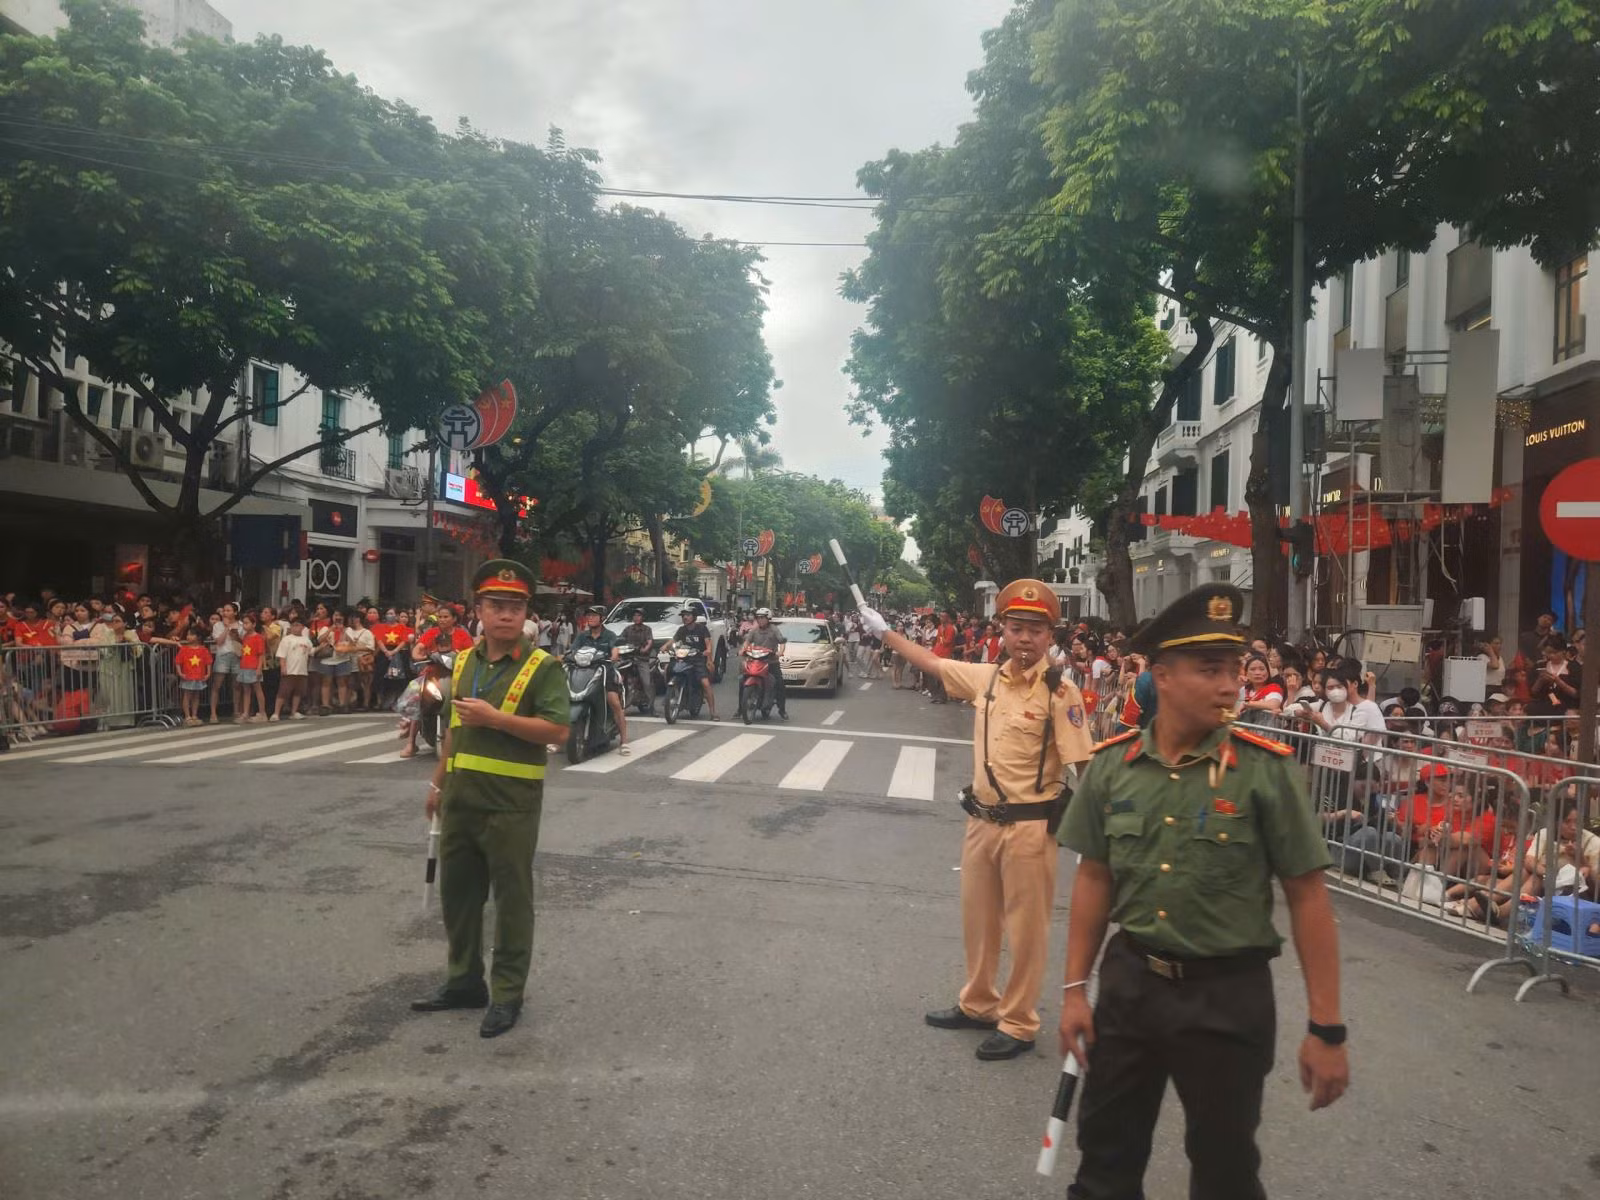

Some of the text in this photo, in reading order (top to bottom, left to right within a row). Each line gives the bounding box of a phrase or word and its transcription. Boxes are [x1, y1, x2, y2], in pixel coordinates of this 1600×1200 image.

[1525, 419, 1585, 447] LOUIS VUITTON
[1321, 755, 1345, 767] STOP
